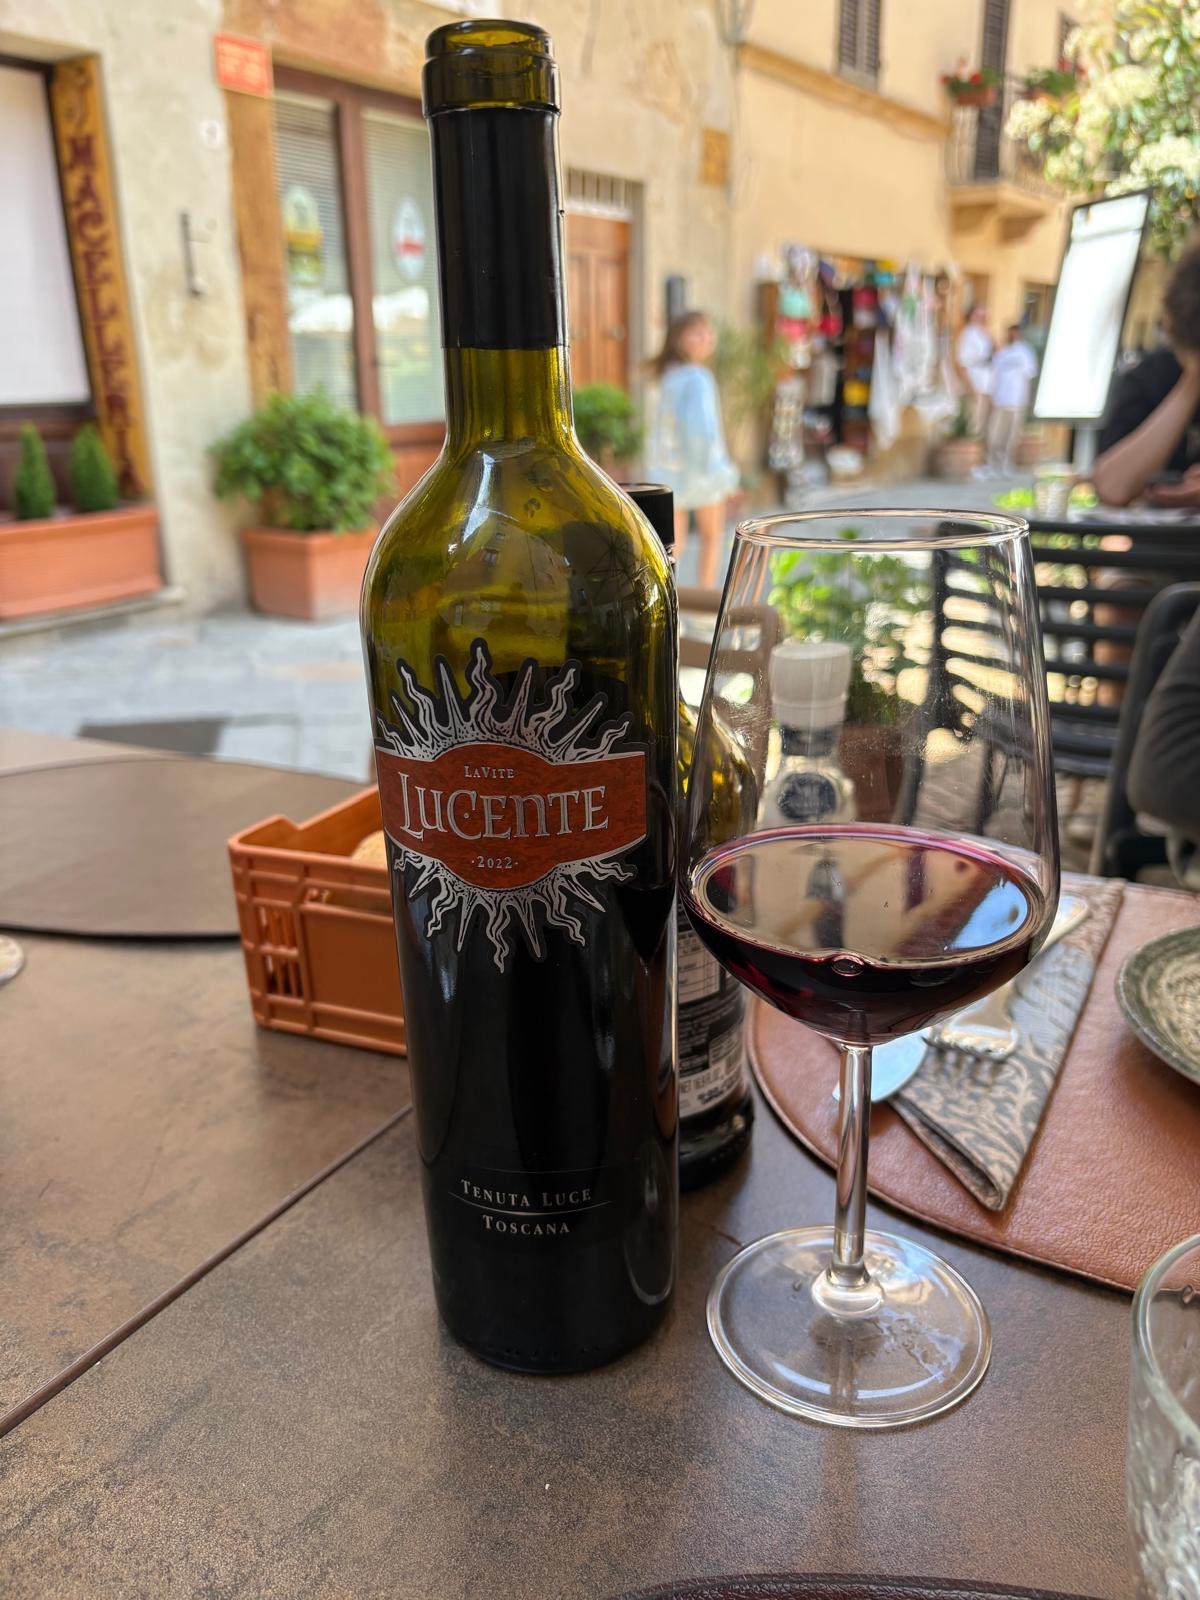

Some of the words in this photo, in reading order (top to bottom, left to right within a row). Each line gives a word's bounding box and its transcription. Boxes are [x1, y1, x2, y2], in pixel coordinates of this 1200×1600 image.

[460, 1179, 531, 1207] TENUTA
[542, 1188, 592, 1207] LUCE
[482, 1214, 570, 1236] TOSCANA
